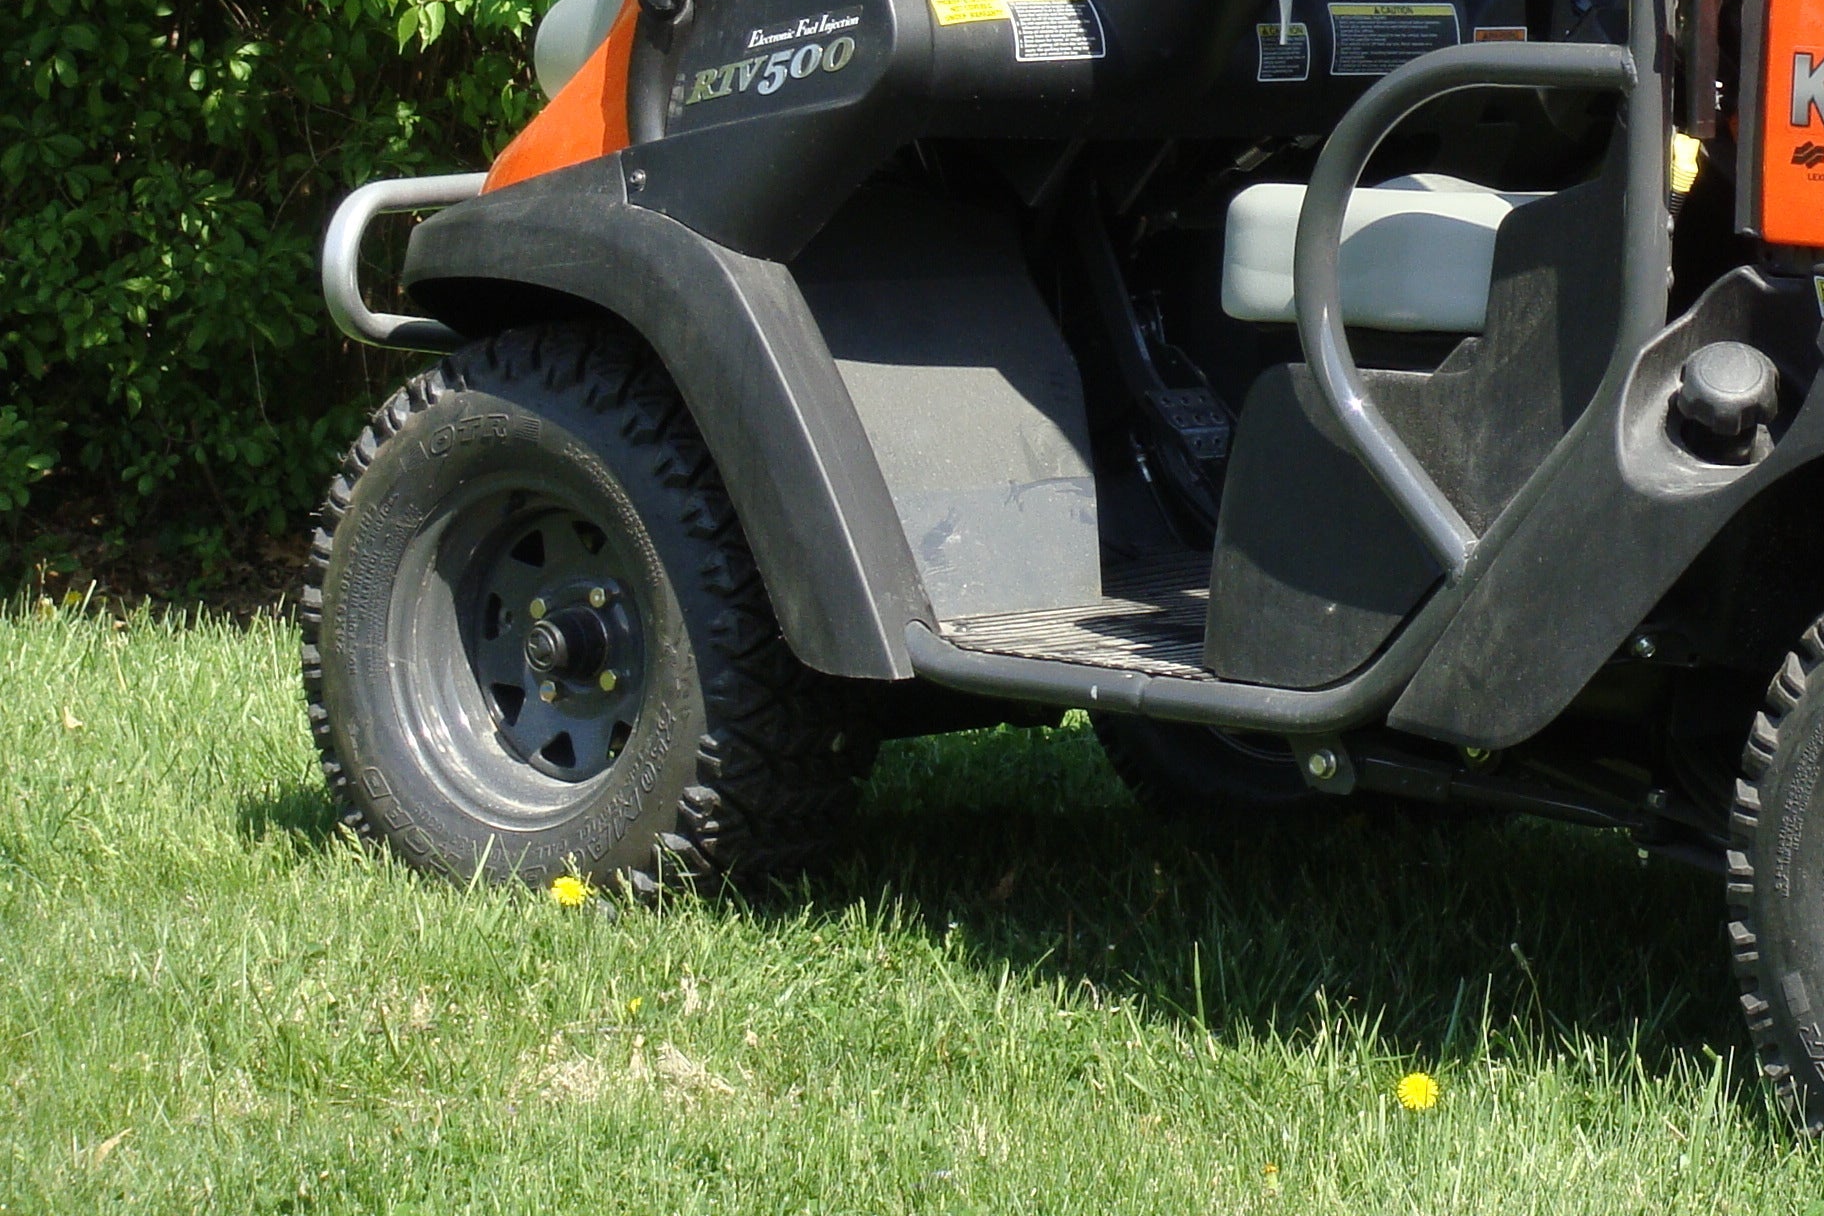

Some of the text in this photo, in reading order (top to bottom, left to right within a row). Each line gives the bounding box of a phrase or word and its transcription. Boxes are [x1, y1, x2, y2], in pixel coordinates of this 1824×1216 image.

[796, 17, 818, 37] Fuel
[818, 14, 860, 34] Injection
[1380, 5, 1414, 15] CAUTION
[685, 36, 856, 106] RTV500
[429, 413, 510, 460] OTR
